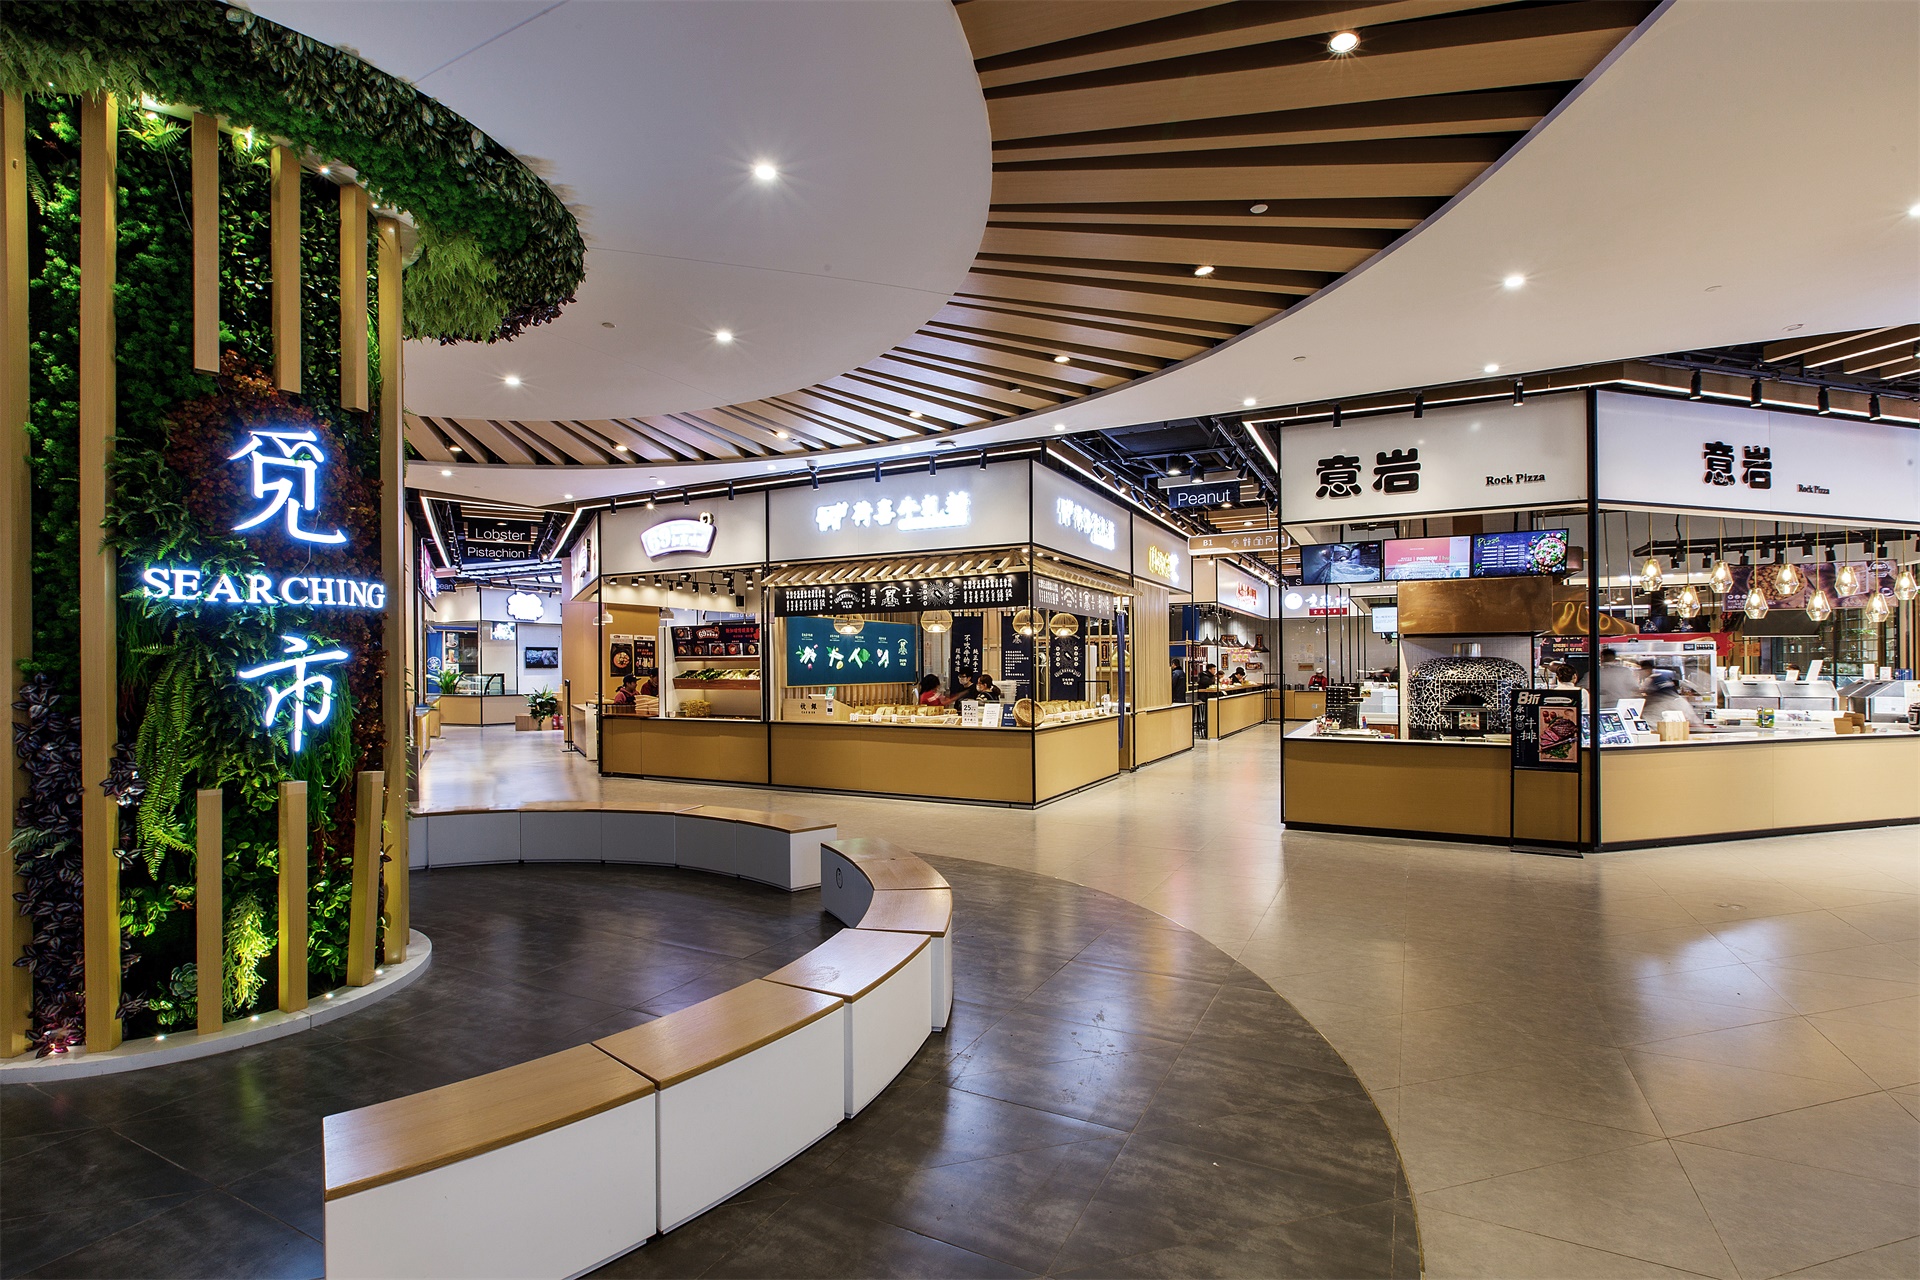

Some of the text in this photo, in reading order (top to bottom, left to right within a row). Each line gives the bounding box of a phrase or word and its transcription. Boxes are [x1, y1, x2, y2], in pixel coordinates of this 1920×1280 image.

[1315, 447, 1422, 499] 意岩
[1702, 441, 1772, 489] 意岩
[226, 430, 347, 544] 觅
[1486, 472, 1545, 487] Rock Pizza
[1177, 489, 1231, 506] Peanut
[1797, 484, 1830, 495] Rock Pizza
[475, 528, 526, 541] Lobster
[1202, 539, 1213, 547] B1
[467, 546, 525, 559] Pistachion
[142, 568, 386, 609] SEARCHING
[238, 635, 348, 752] 市
[1517, 691, 1541, 705] 8折
[1520, 717, 1537, 743] 牛排
